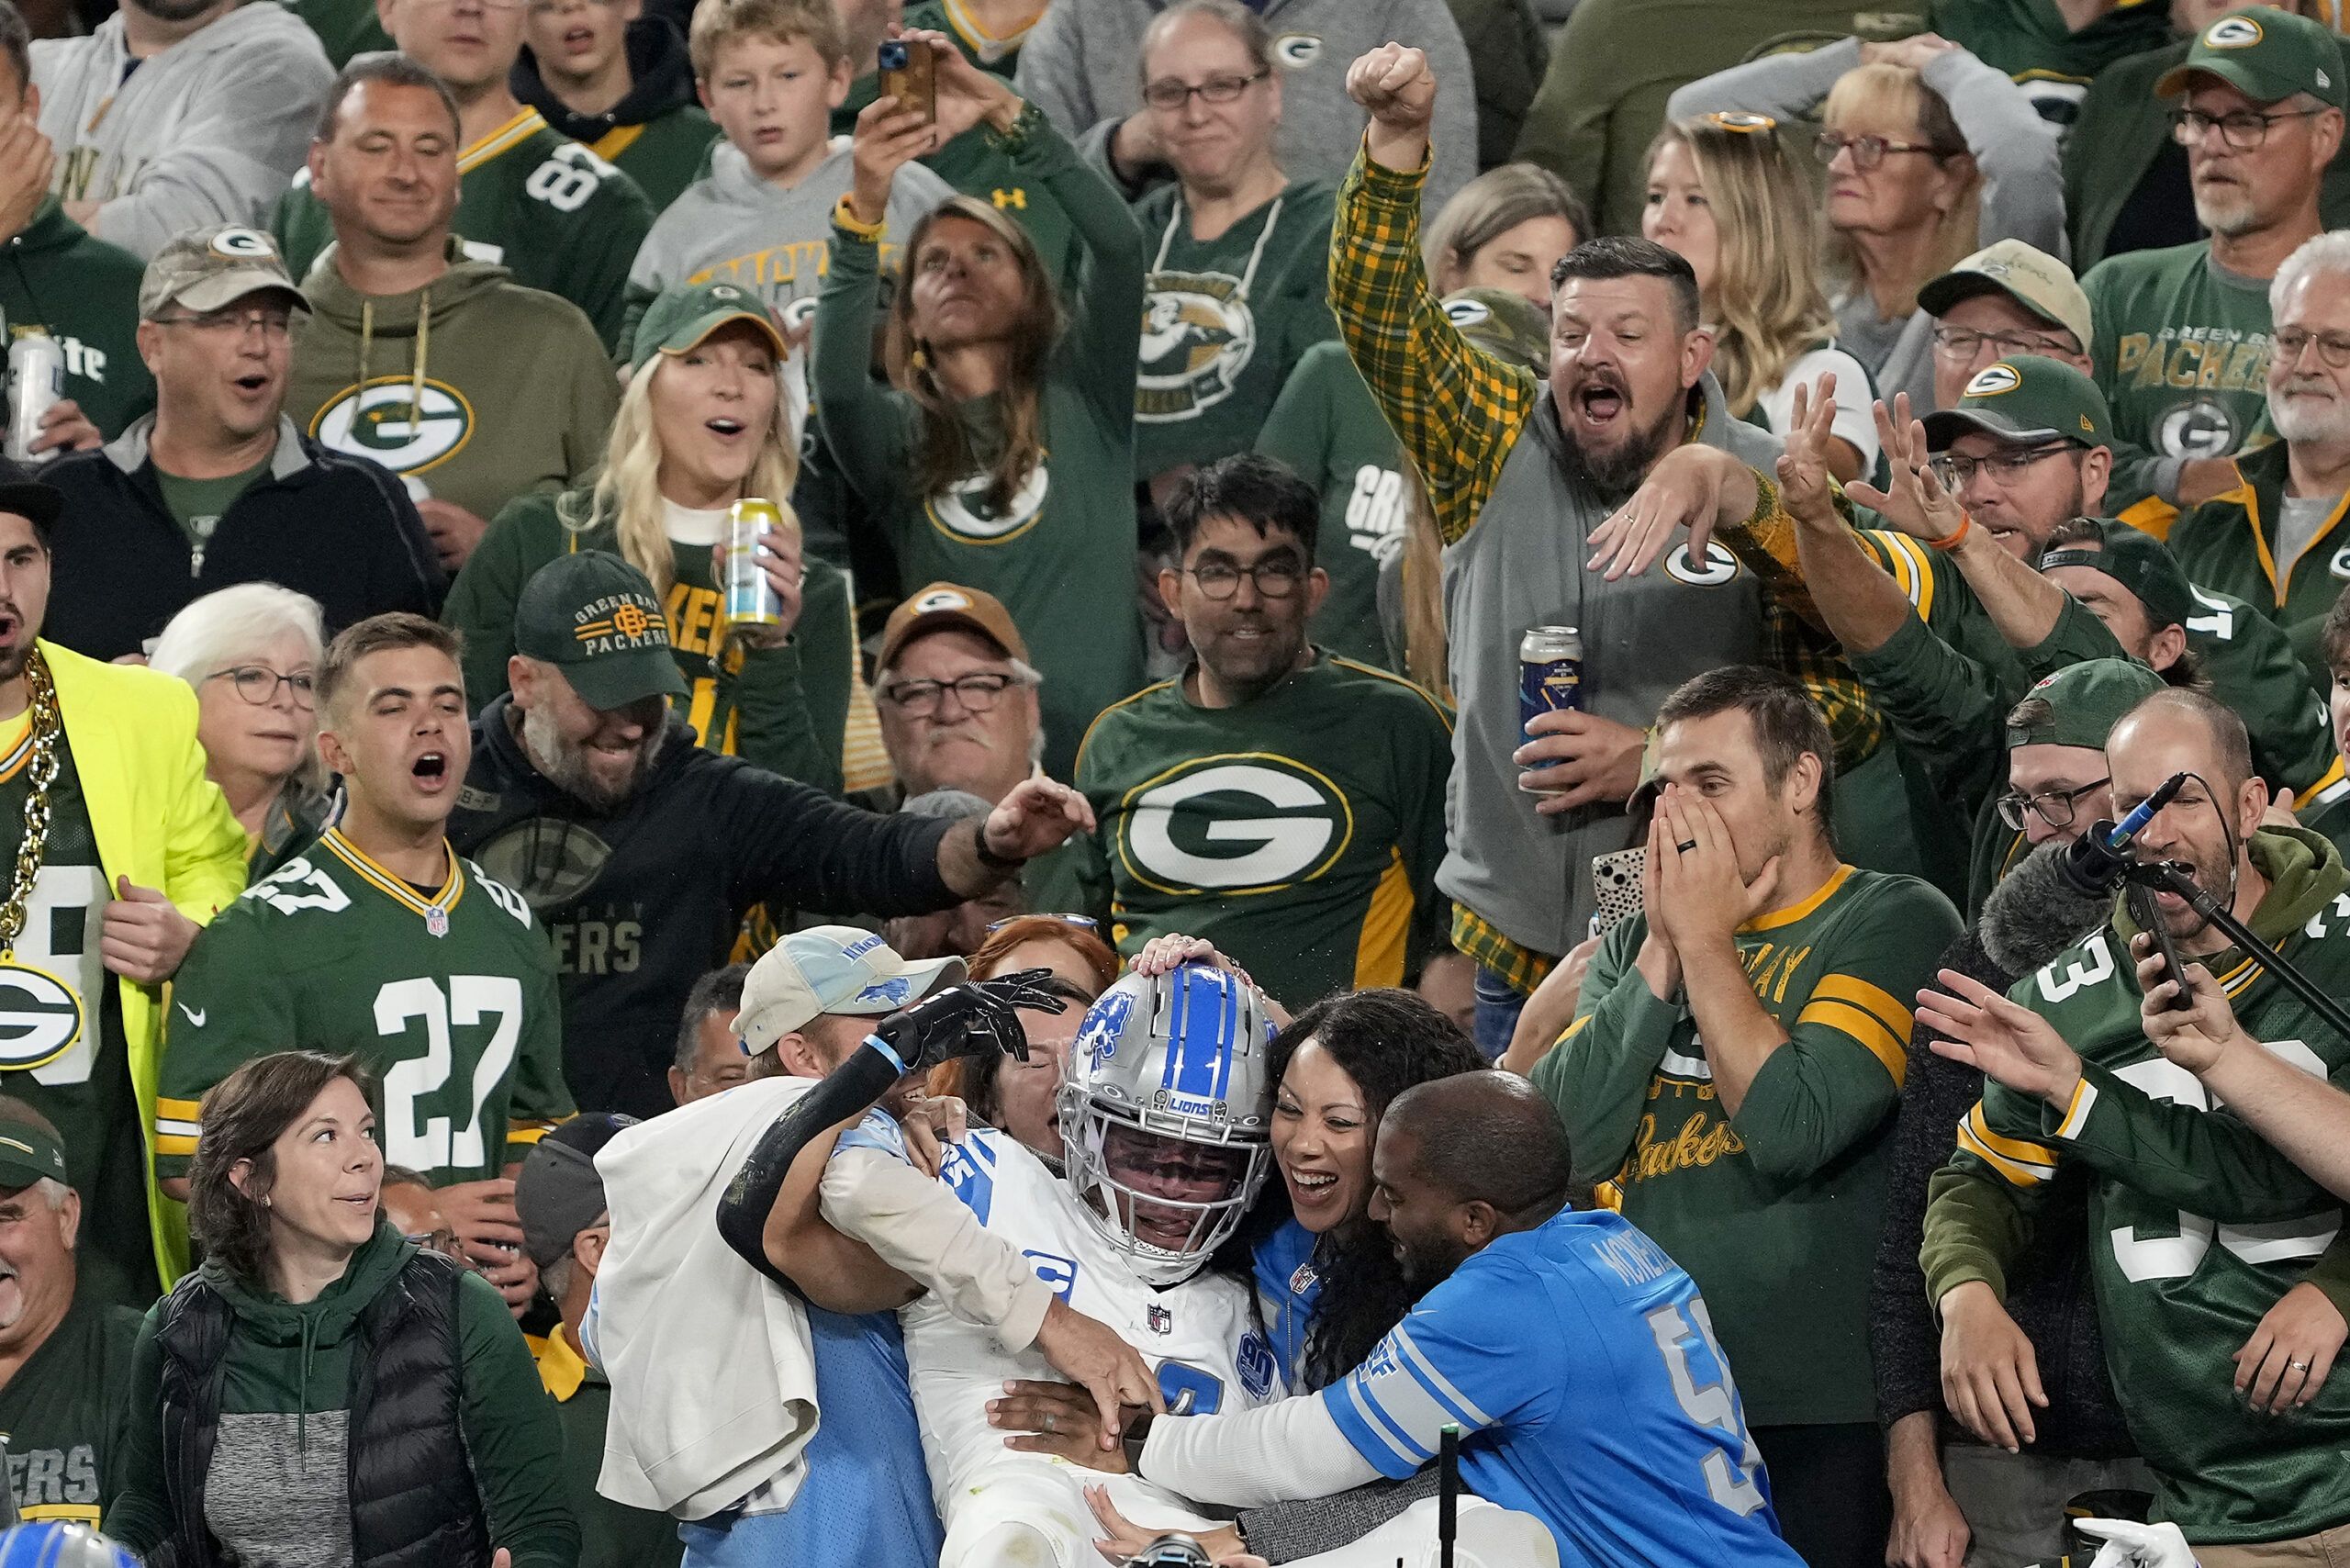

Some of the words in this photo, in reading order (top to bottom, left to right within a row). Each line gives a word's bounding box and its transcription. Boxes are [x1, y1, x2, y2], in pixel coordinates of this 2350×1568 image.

[319, 375, 463, 471] G
[2162, 401, 2231, 460] G
[1666, 542, 1736, 585] G
[575, 592, 632, 624] GREEN
[585, 630, 668, 656] PACKERS
[1130, 765, 1333, 887] G
[241, 857, 352, 916] 27
[553, 921, 643, 975] ERS
[373, 975, 522, 1172] 27
[6, 1443, 99, 1507] ERS
